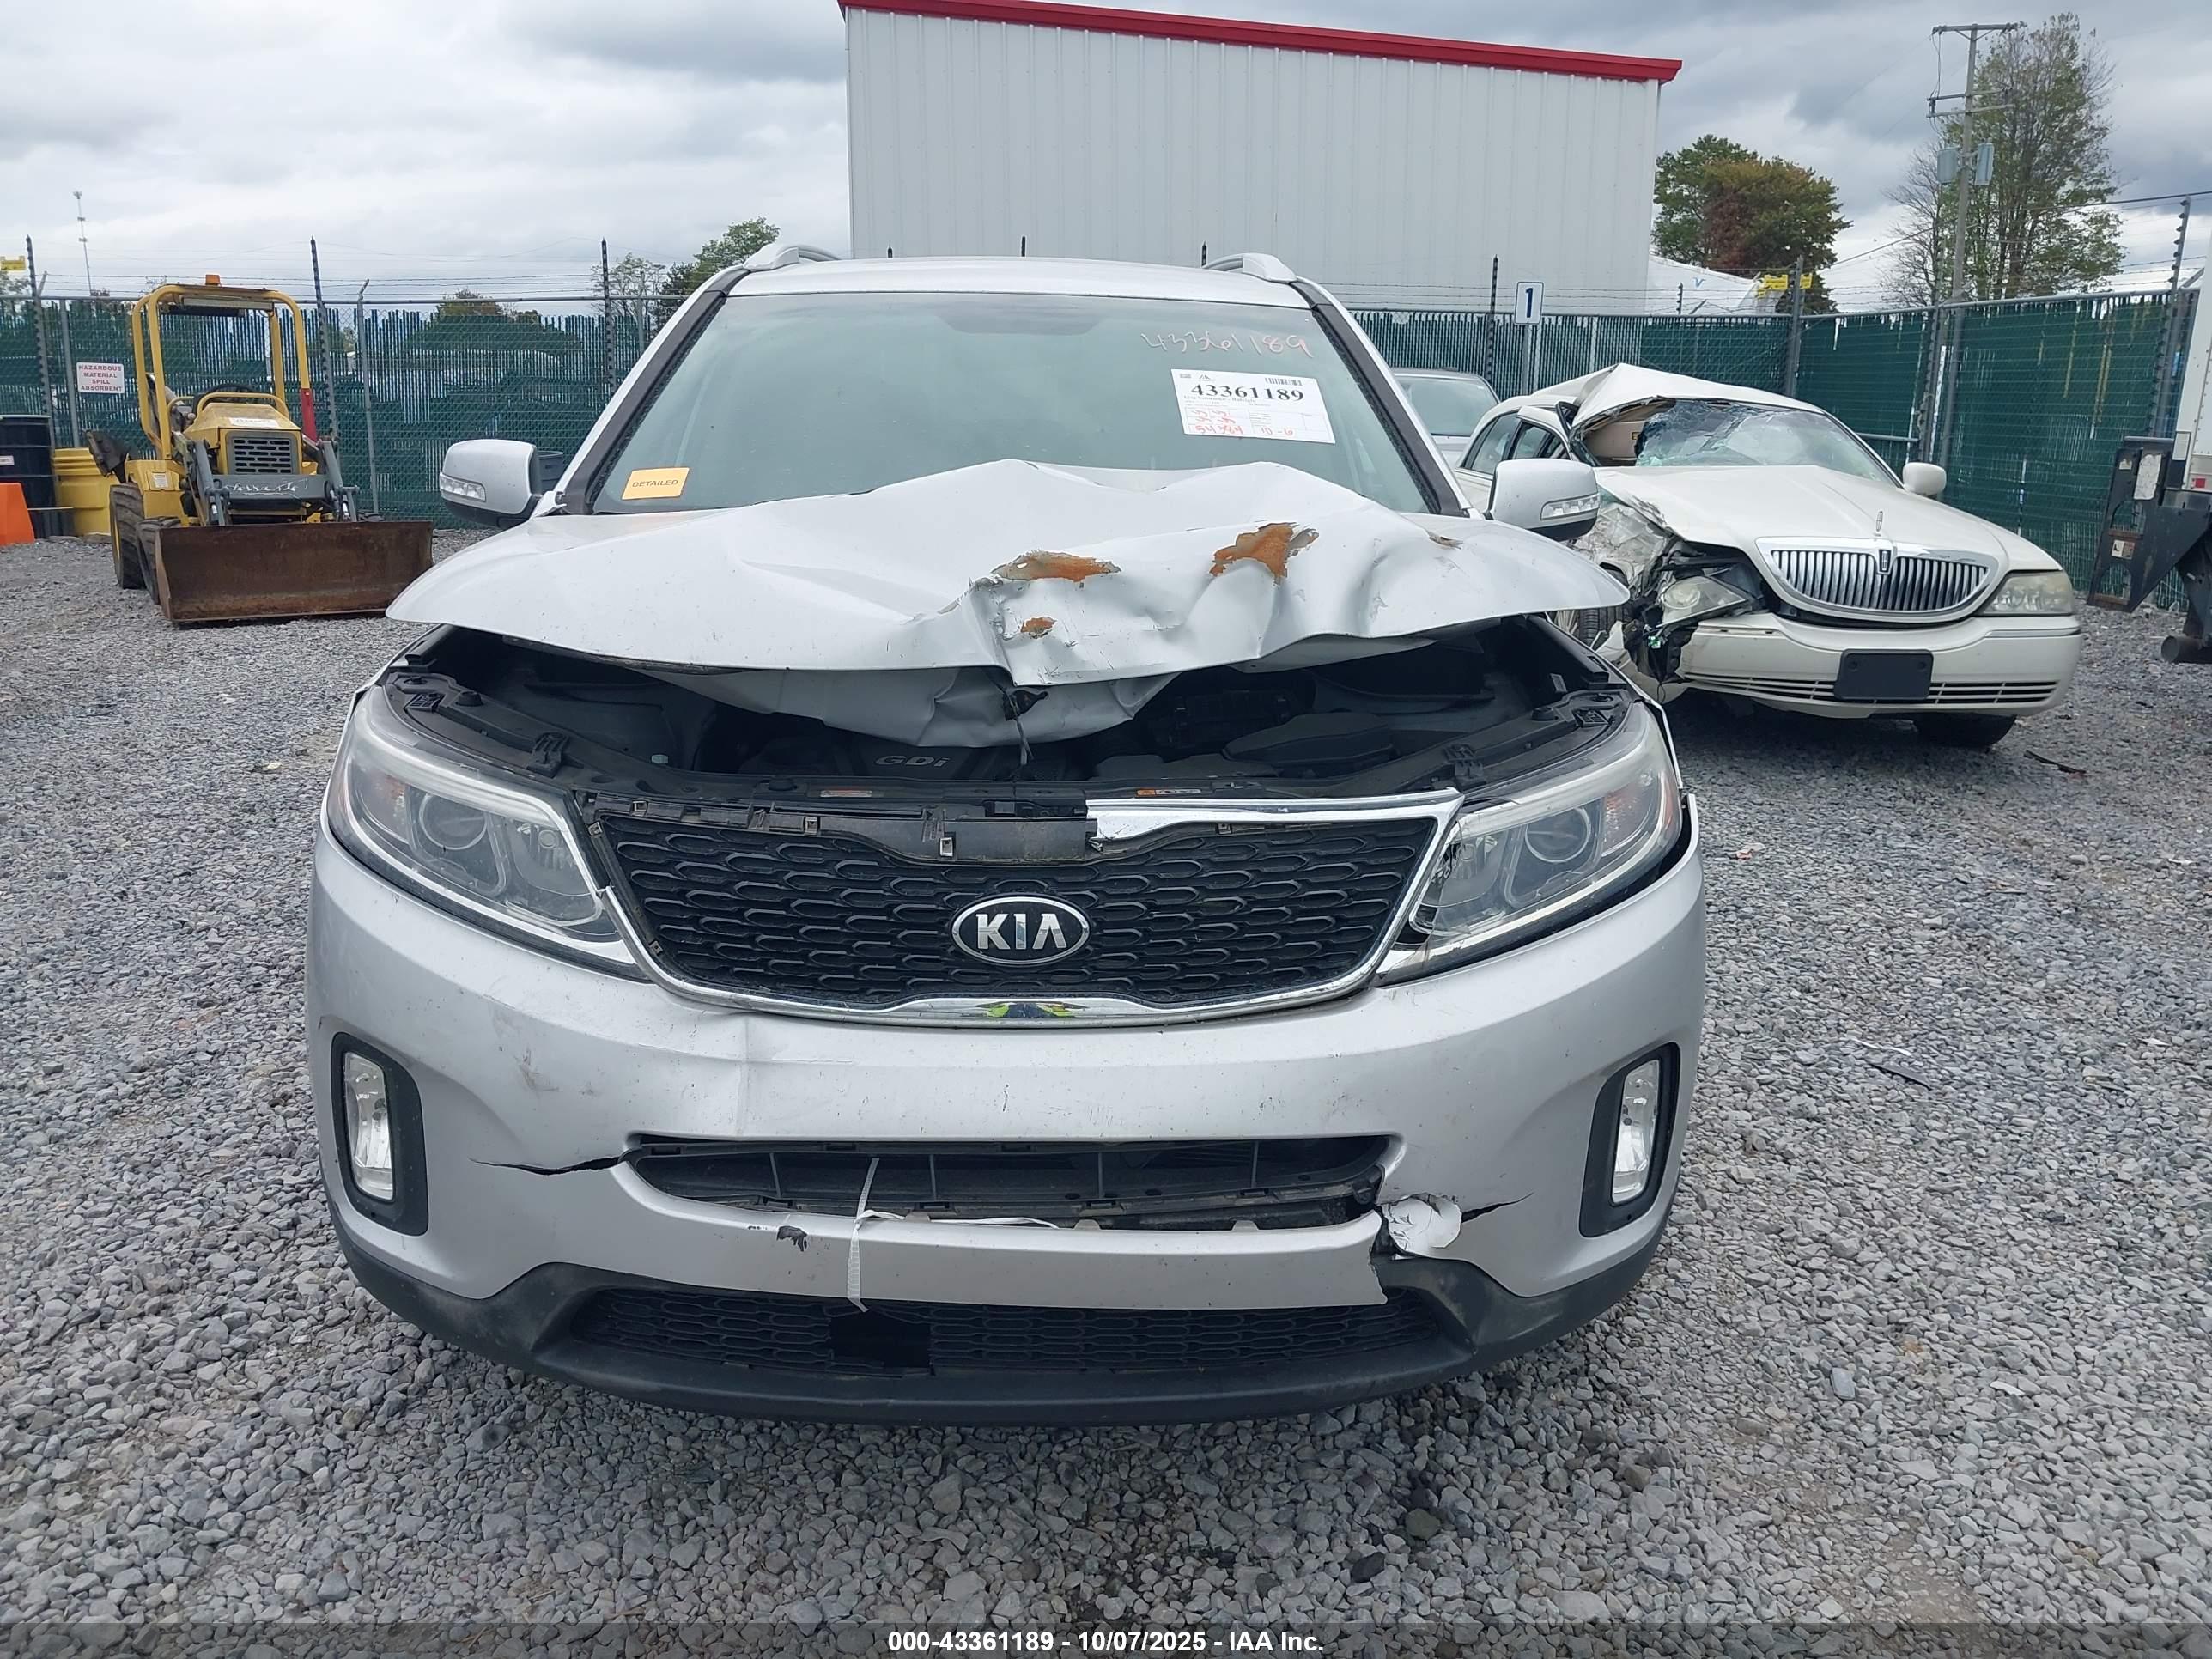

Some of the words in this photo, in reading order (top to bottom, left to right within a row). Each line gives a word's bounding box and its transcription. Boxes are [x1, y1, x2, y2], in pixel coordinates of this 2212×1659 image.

[1525, 287, 1534, 319] 1
[1191, 384, 1304, 402] 43361189
[632, 479, 679, 488] DETAILED
[875, 755, 951, 767] GDi
[975, 913, 1067, 950] KIA
